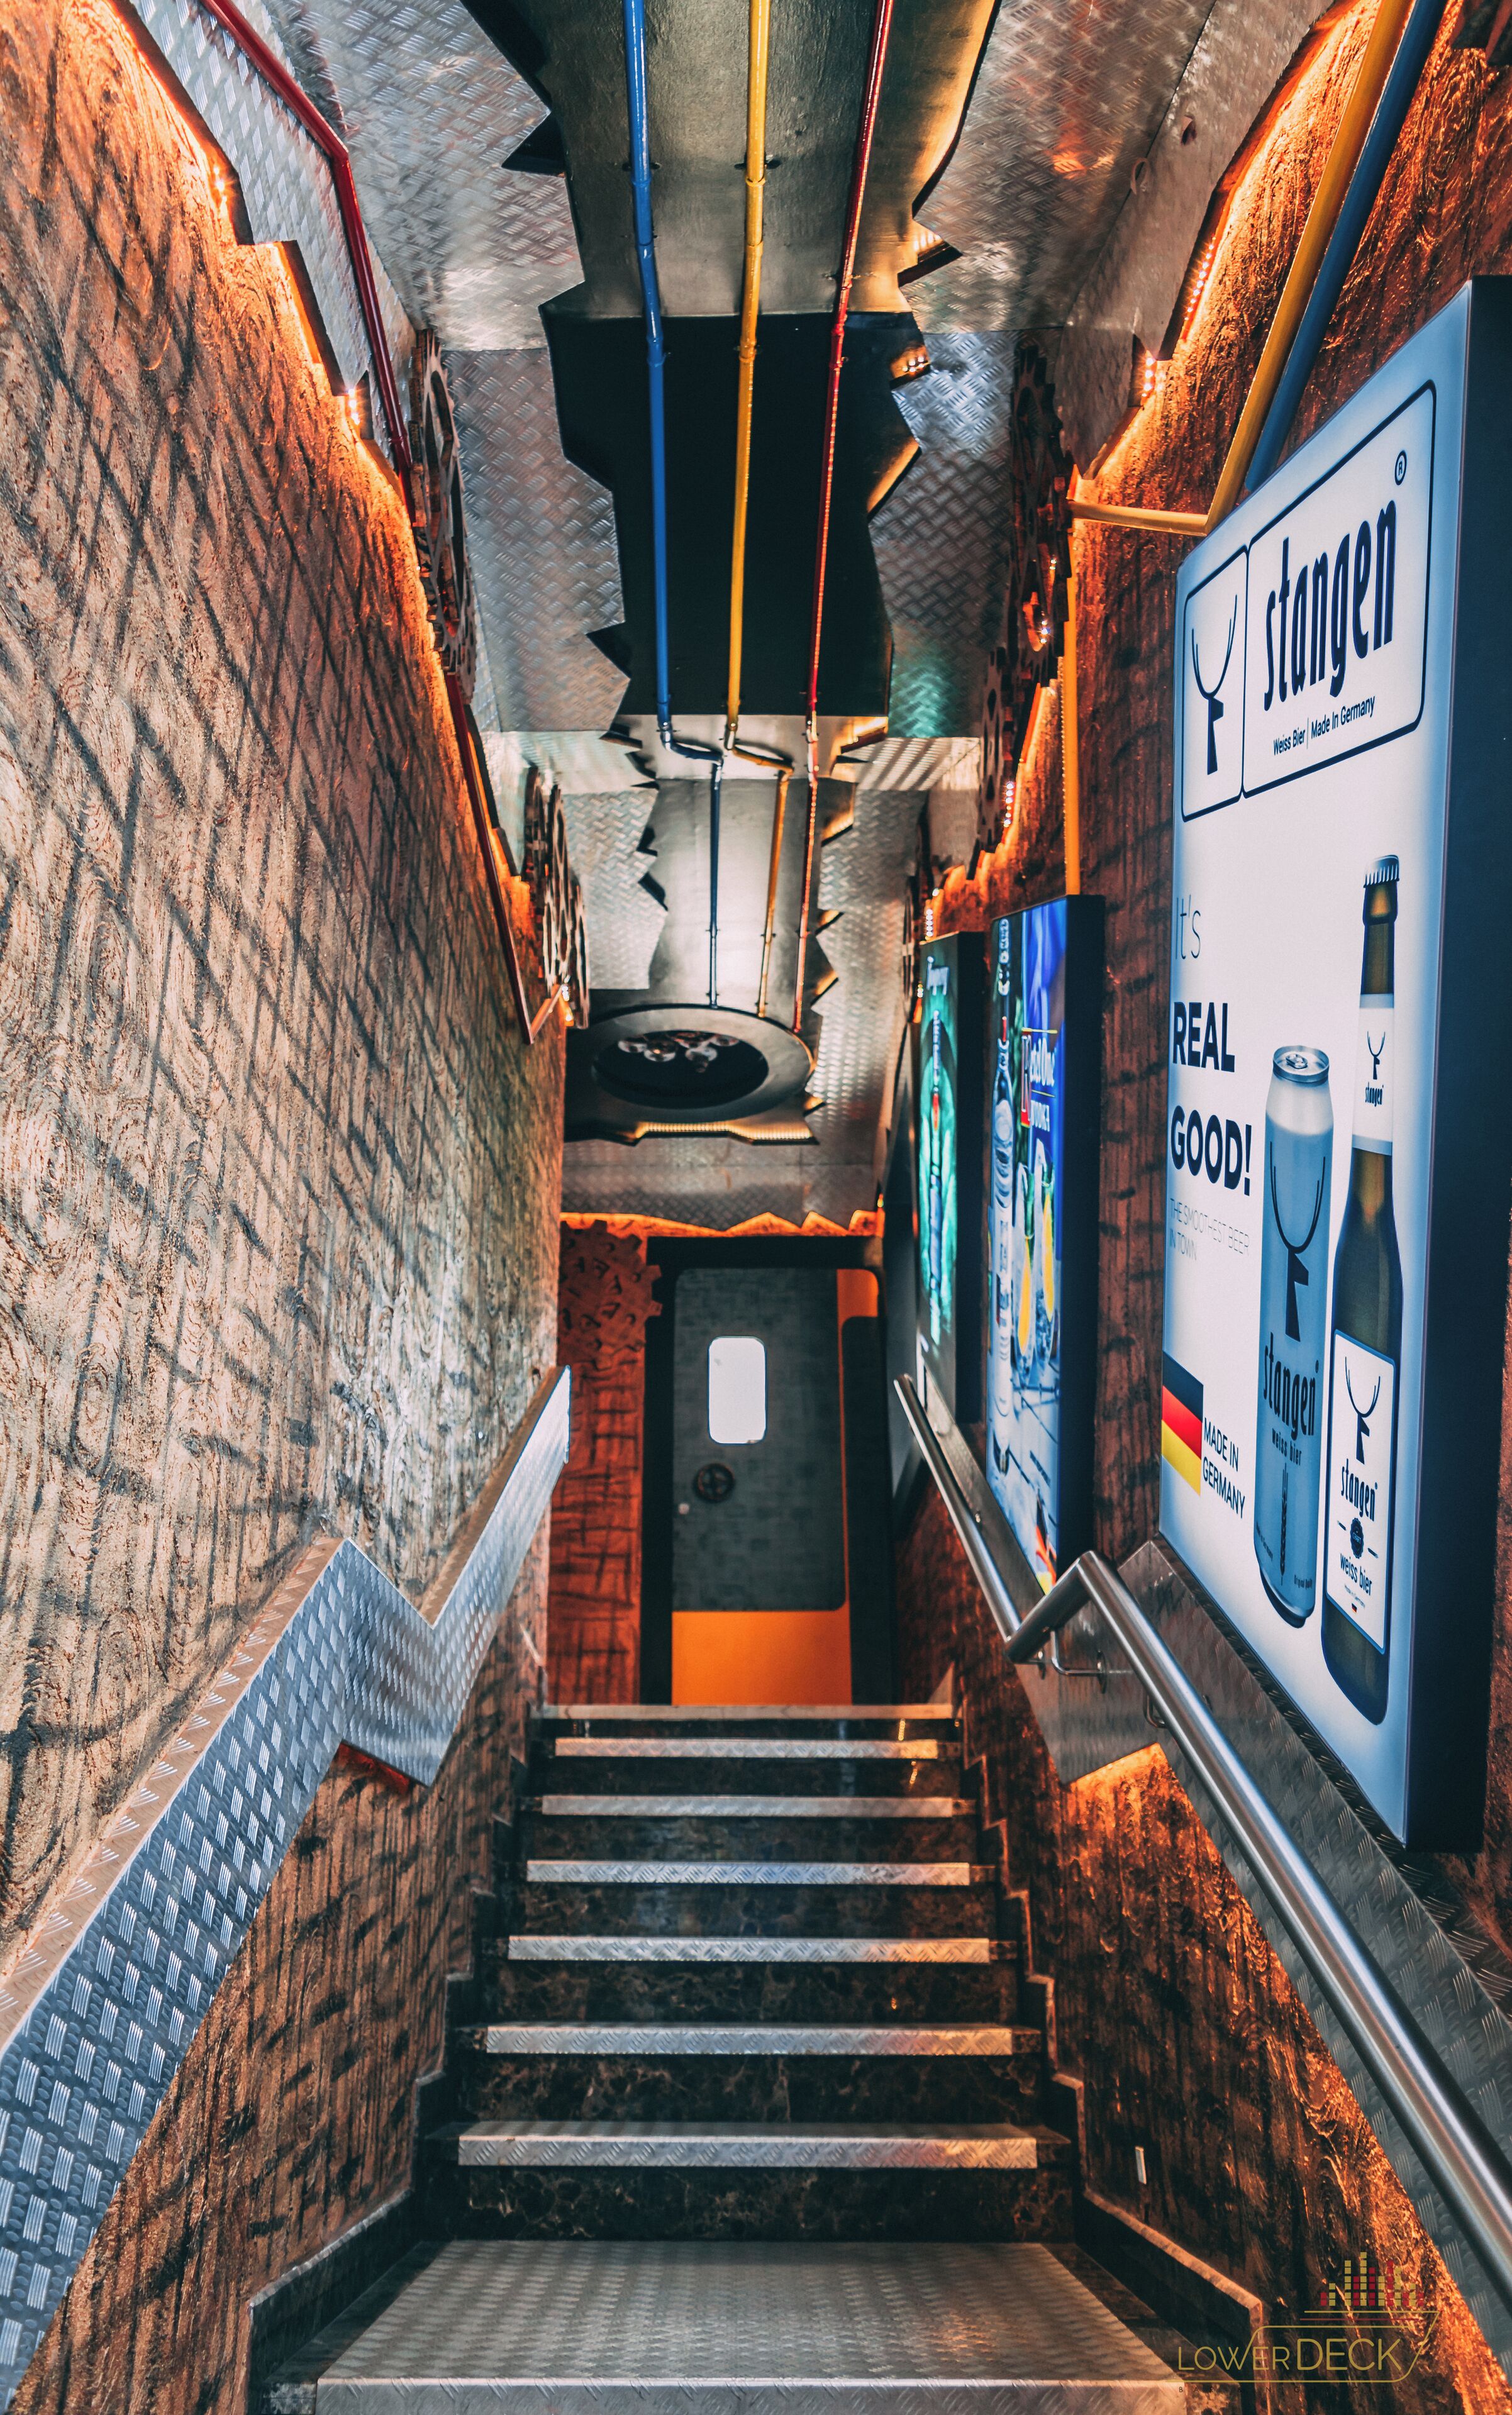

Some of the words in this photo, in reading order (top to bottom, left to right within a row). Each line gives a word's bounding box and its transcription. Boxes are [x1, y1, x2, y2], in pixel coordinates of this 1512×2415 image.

[1264, 499, 1396, 711] stangen
[1273, 735, 1291, 756] Weiss
[1292, 726, 1306, 748] Bier
[1311, 714, 1330, 739] Made
[1331, 711, 1339, 730] In
[1340, 695, 1376, 726] Germany
[1174, 894, 1201, 960] It's
[1172, 1001, 1235, 1073] REAL
[1170, 1104, 1252, 1196] GOOD!
[1169, 1197, 1182, 1223] THE
[1183, 1204, 1227, 1244] SMOOTHEST
[1228, 1226, 1250, 1257] BEER
[1177, 1231, 1197, 1261] TOWN
[1263, 1331, 1316, 1441] stangen
[1204, 1417, 1228, 1463] MADE
[1230, 1441, 1239, 1472] IN
[1272, 1428, 1288, 1458] weiss
[1289, 1440, 1302, 1466] bier
[1203, 1456, 1245, 1519] GERMANY
[1340, 1458, 1376, 1522] stangen
[1340, 1552, 1358, 1584] weiss
[1359, 1565, 1372, 1596] bier
